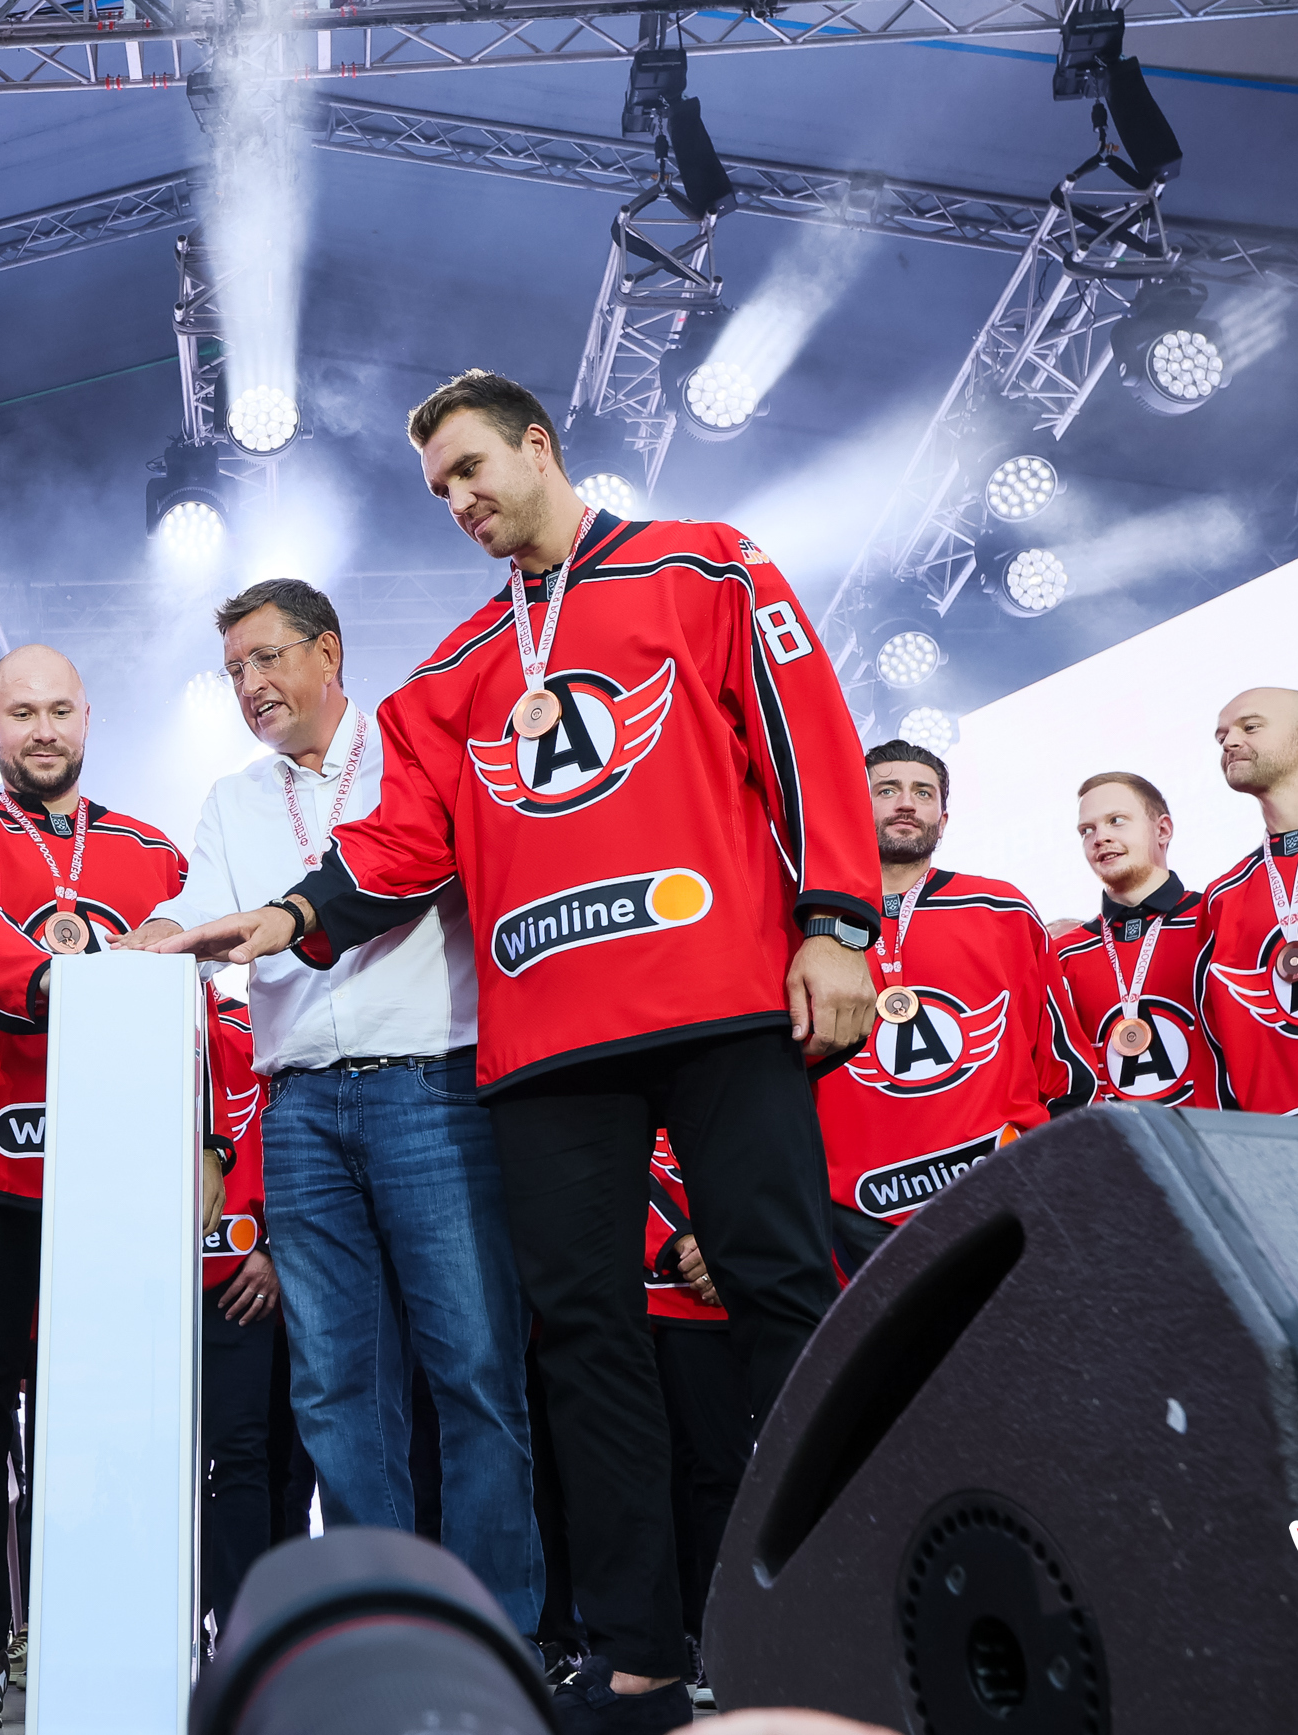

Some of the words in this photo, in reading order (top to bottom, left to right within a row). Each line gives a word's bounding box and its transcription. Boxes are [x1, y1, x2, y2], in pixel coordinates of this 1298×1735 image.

[755, 600, 814, 665] 8
[532, 675, 604, 789] A
[502, 897, 636, 961] Winline
